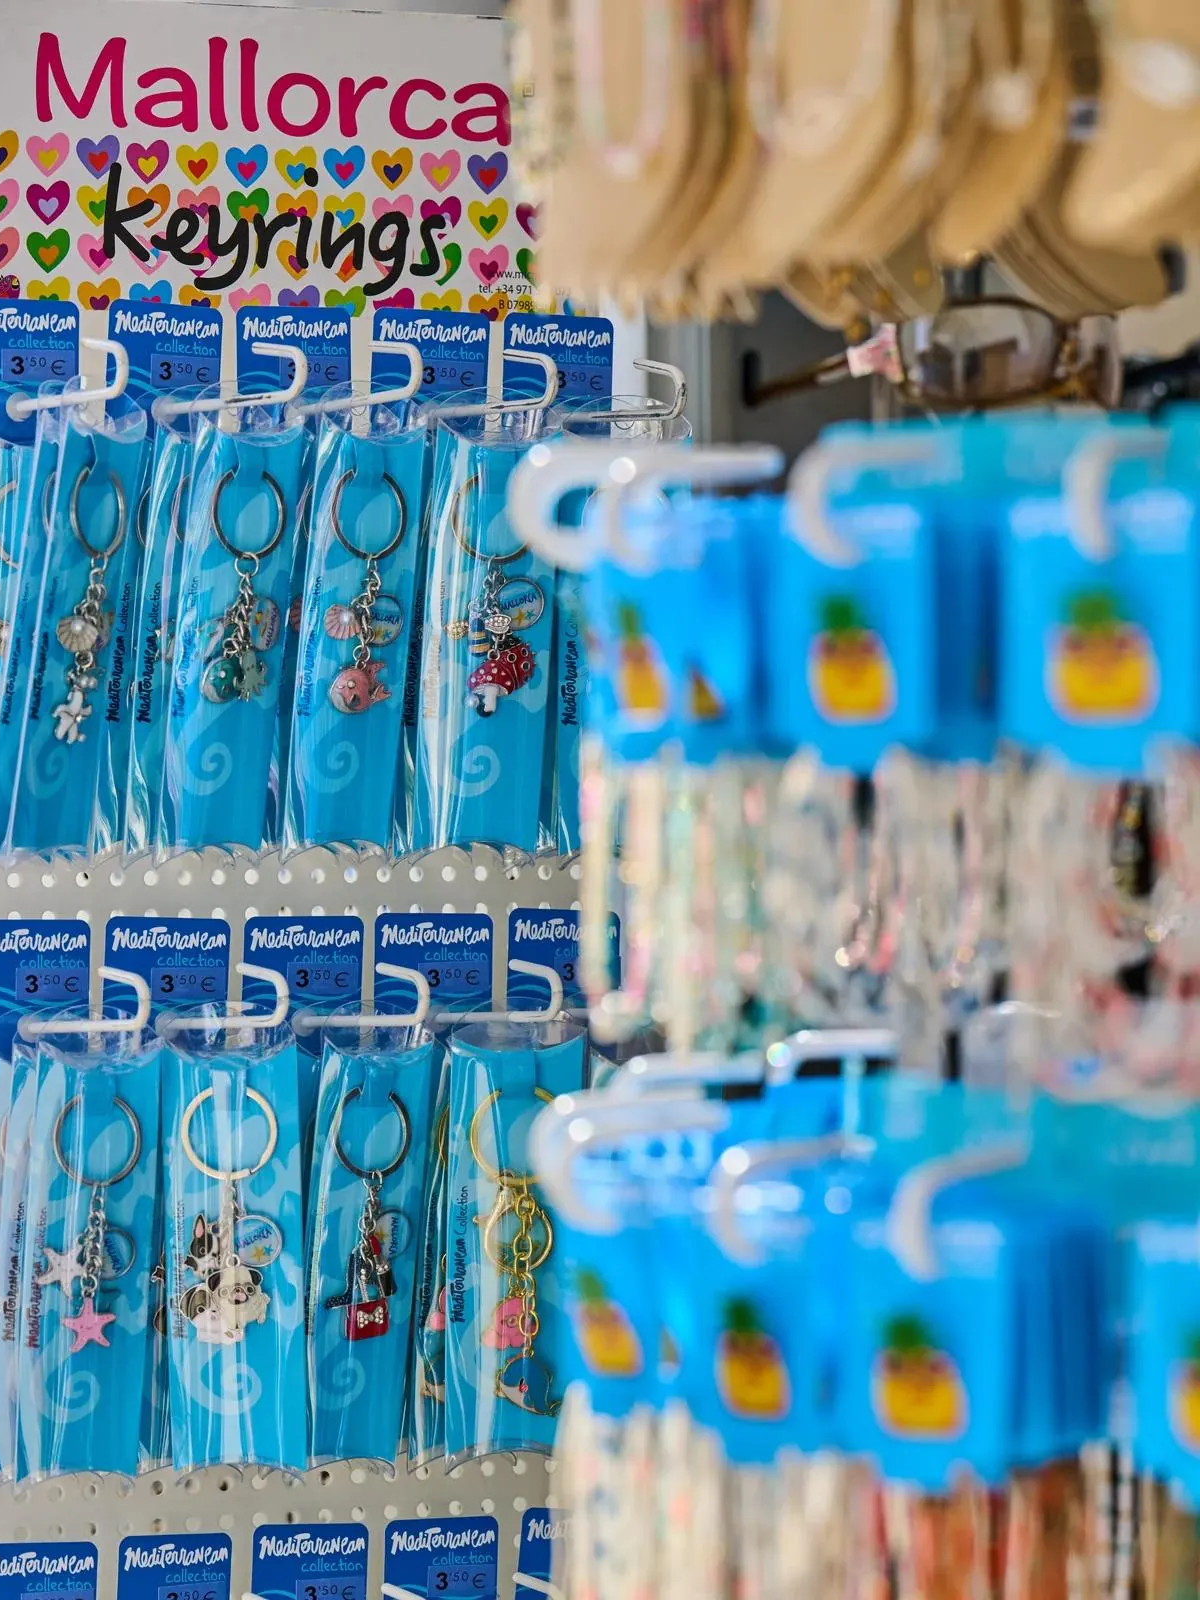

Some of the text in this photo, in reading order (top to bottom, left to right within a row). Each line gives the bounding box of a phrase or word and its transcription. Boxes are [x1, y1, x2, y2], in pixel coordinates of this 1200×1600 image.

[36, 32, 511, 147] Mallorca
[101, 162, 446, 296] keyrings
[479, 283, 493, 294] tel.
[516, 285, 532, 295] 971
[498, 299, 505, 310] B
[8, 335, 75, 349] collection
[156, 341, 218, 357] collection
[301, 341, 347, 356] llection
[421, 344, 485, 361] collection
[20, 954, 86, 969] collection
[157, 952, 225, 968] collection
[294, 950, 358, 964] collection
[424, 947, 488, 962] collection
[301, 1557, 363, 1573] collection
[432, 1551, 494, 1566] collection
[165, 1568, 226, 1584] collection
[27, 1578, 94, 1593] collection
